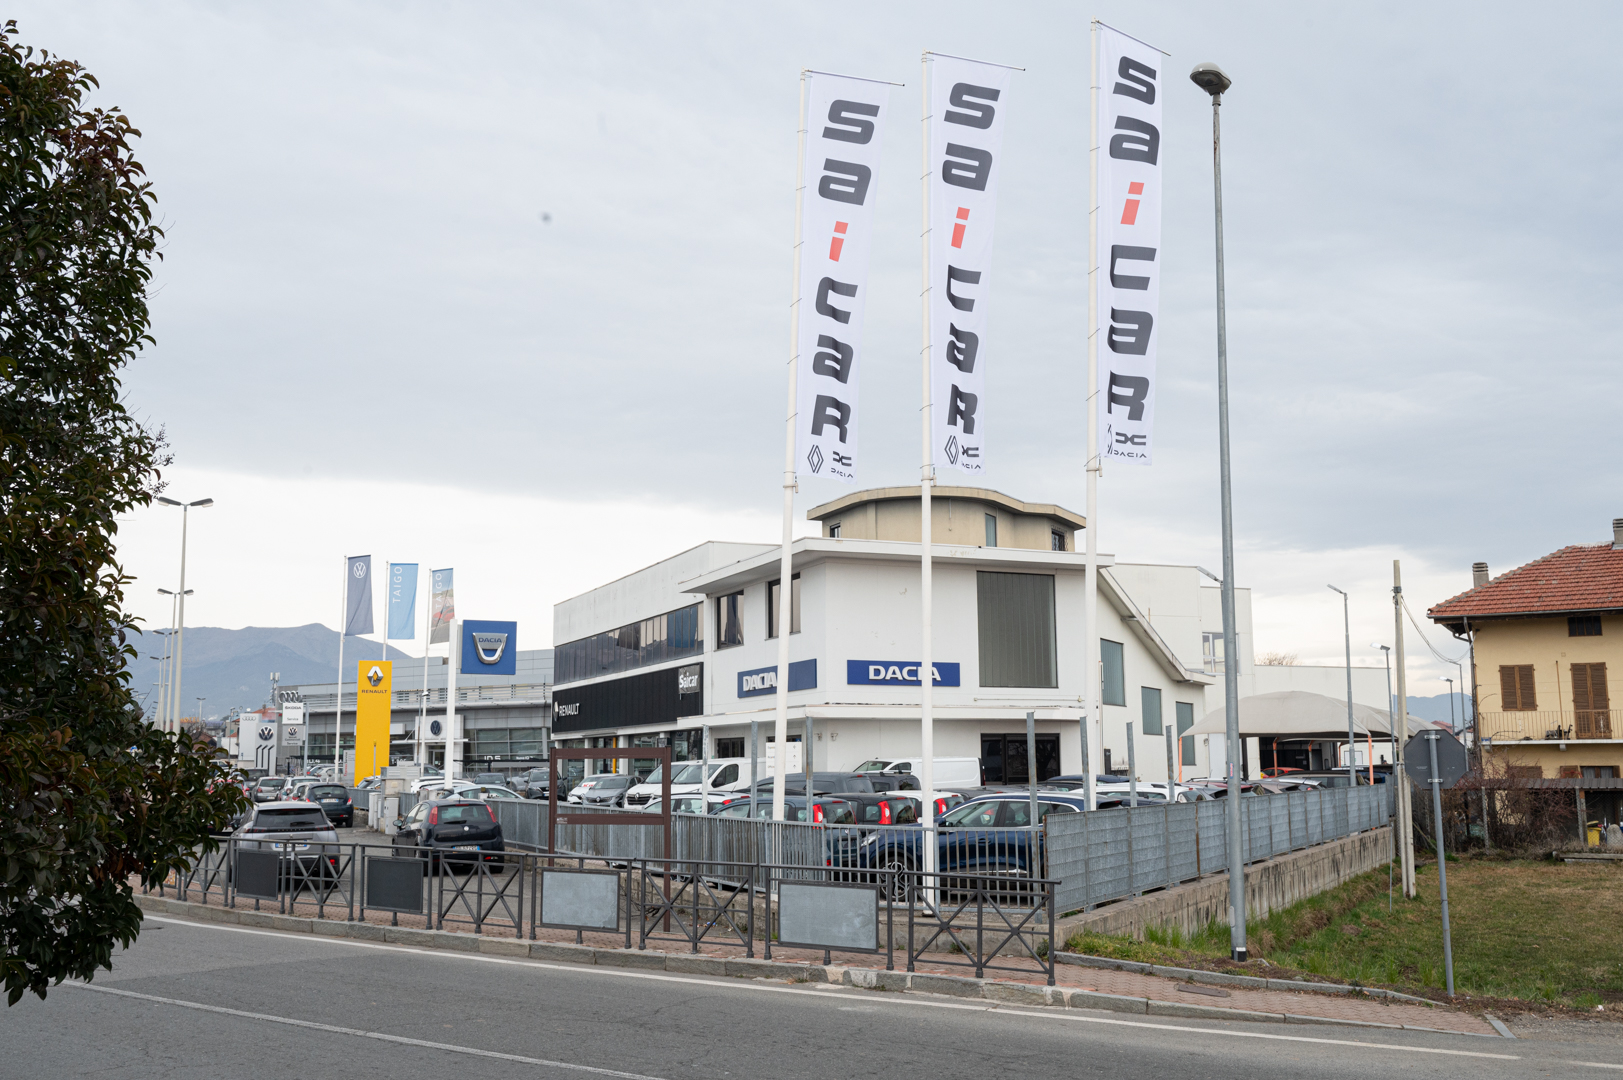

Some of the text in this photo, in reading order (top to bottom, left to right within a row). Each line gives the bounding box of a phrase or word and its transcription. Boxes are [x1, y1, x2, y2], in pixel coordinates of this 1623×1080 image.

[392, 566, 403, 604] TAIGO
[435, 573, 443, 610] TAIGO
[742, 671, 778, 692] DACIA
[558, 702, 580, 717] RENAULT
